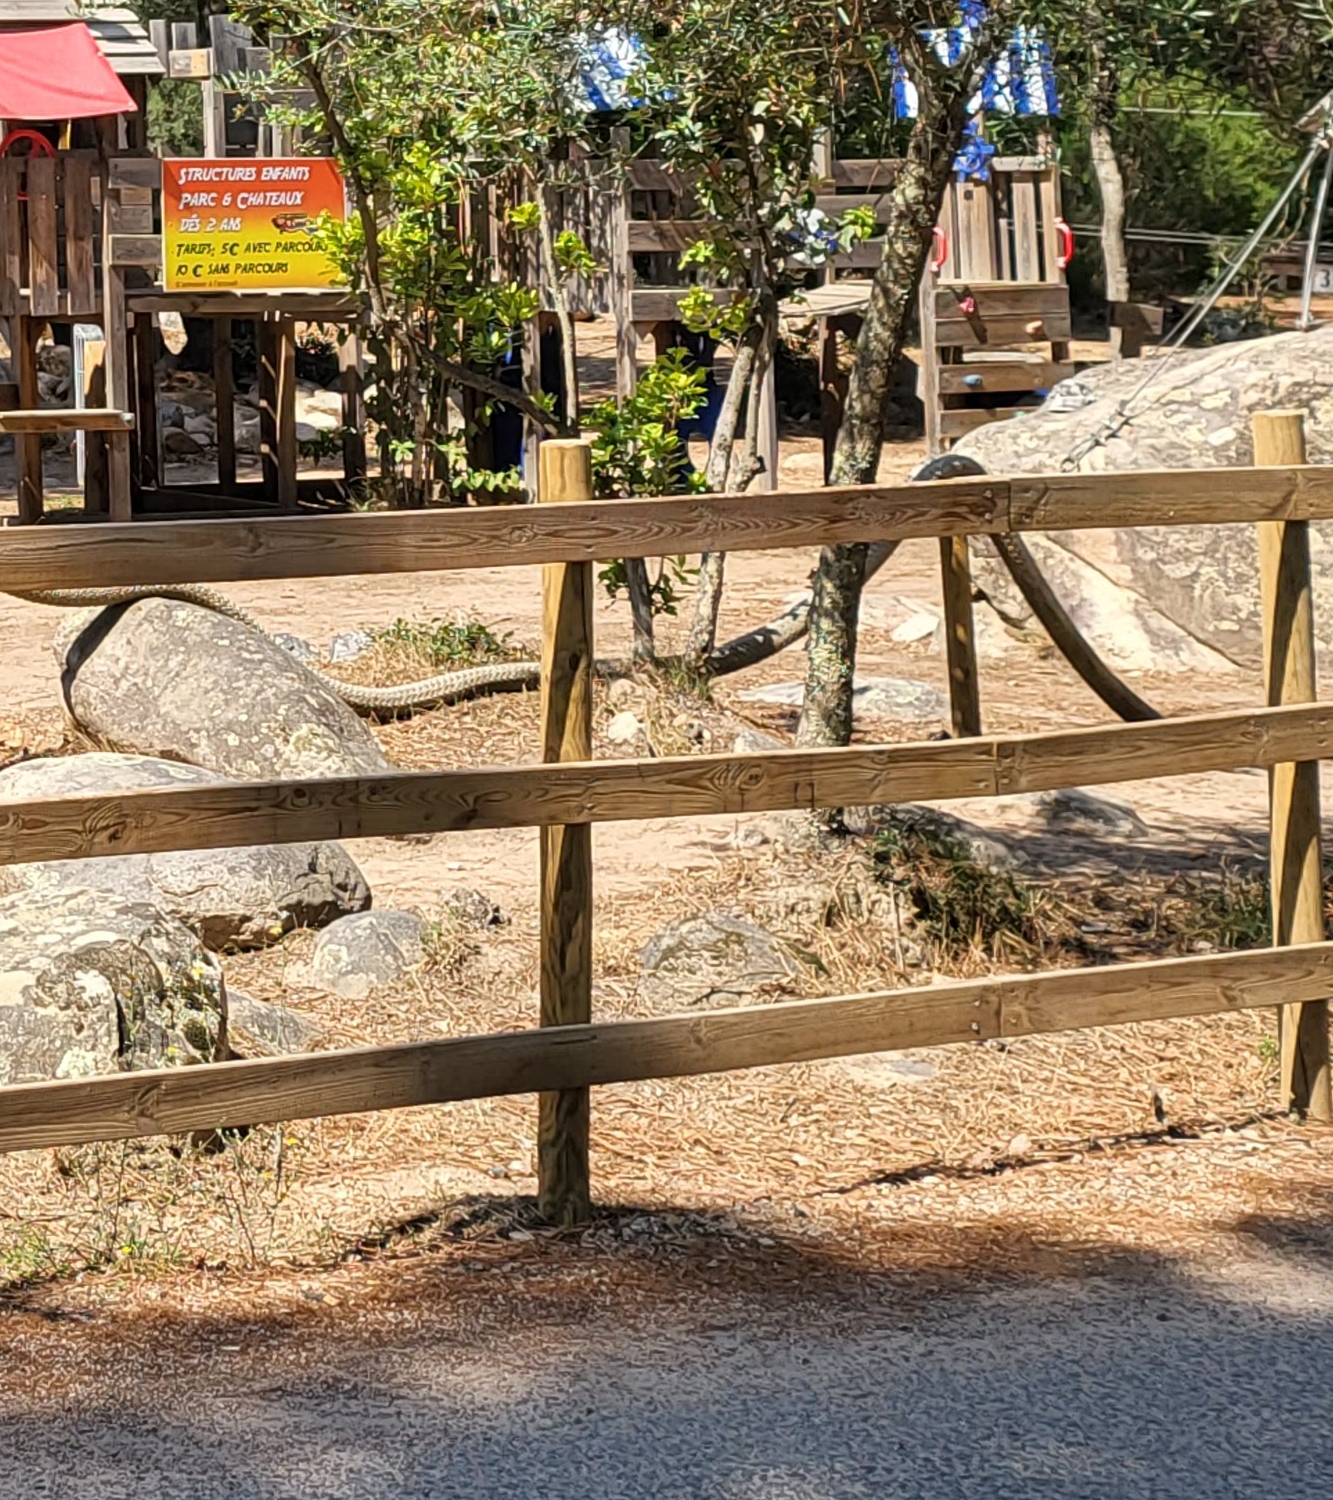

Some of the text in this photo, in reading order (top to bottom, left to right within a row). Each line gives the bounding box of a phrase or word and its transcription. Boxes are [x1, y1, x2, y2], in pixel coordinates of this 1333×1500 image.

[178, 166, 310, 185] STRUCTURES ENFANTS
[178, 192, 218, 210] PARC
[237, 191, 305, 209] CHATEAUX
[205, 217, 217, 231] 2
[219, 217, 242, 232] ANS
[244, 242, 272, 253] AVEC
[175, 264, 188, 276] 10
[207, 263, 230, 275] SANS
[234, 262, 289, 274] PARCOURS
[1320, 269, 1331, 288] 3
